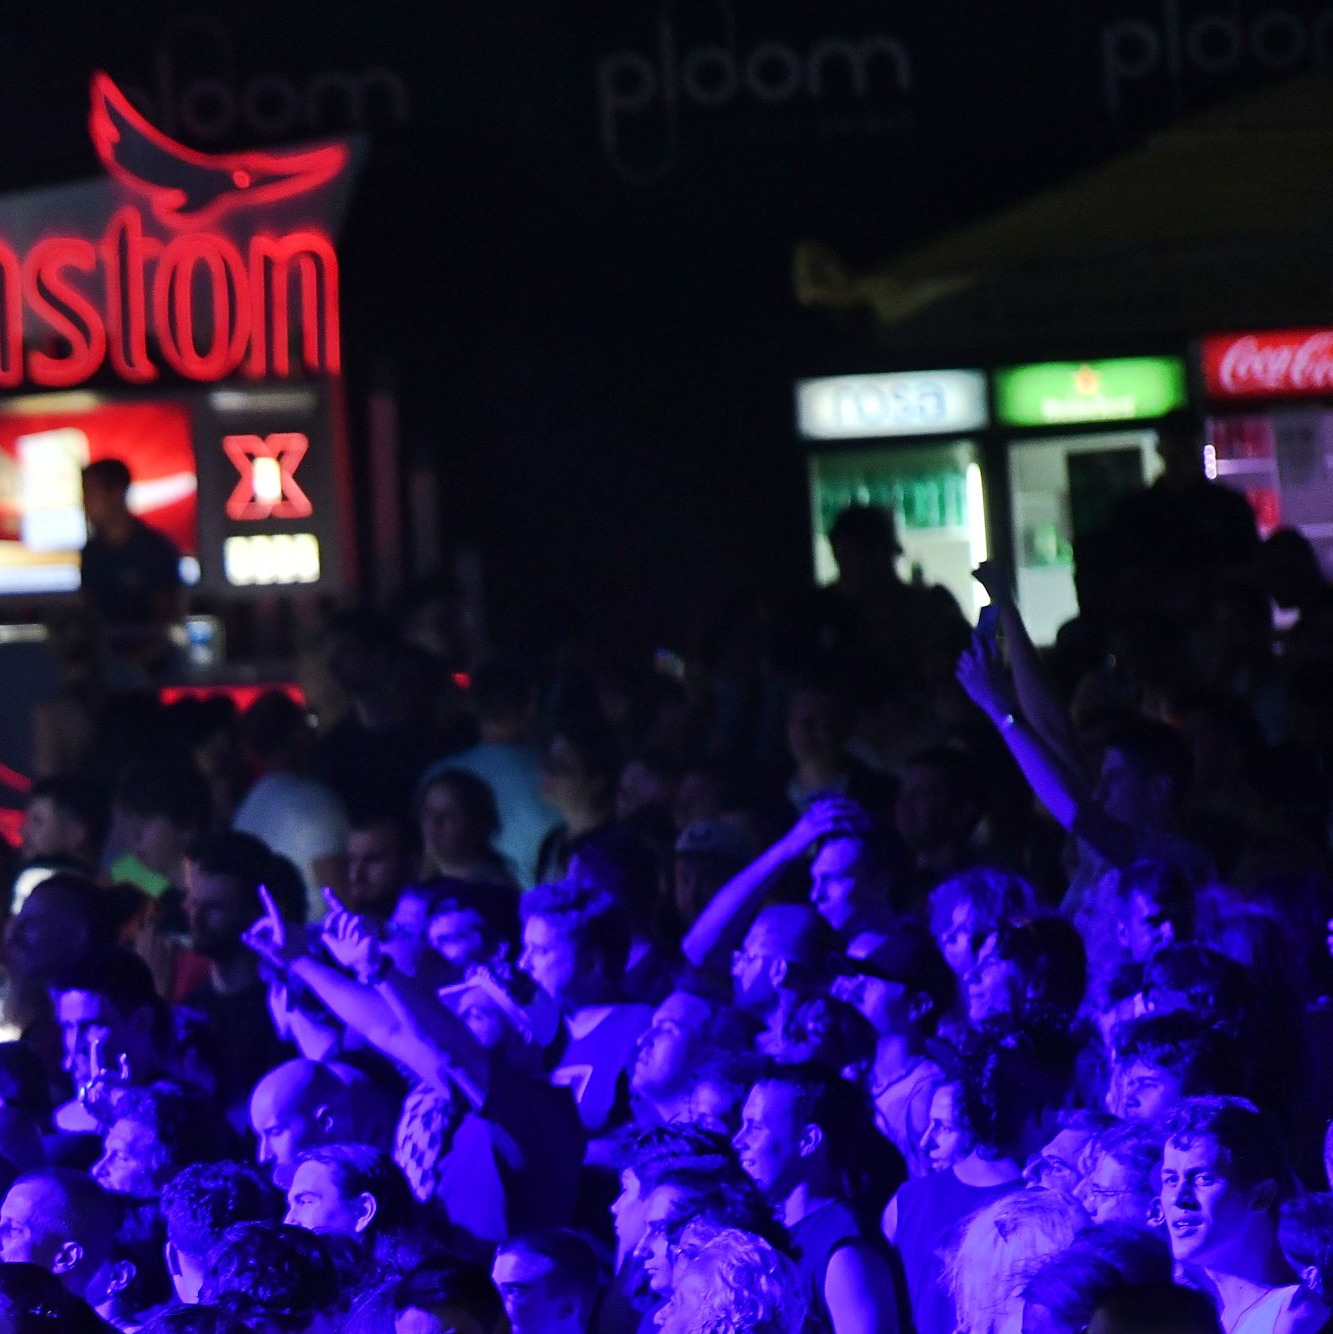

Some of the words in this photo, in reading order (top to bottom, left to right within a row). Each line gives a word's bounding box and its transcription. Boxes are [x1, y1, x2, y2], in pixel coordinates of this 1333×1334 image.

[130, 17, 411, 140] loom
[594, 2, 911, 185] ploom
[1101, 0, 1333, 125] ploo
